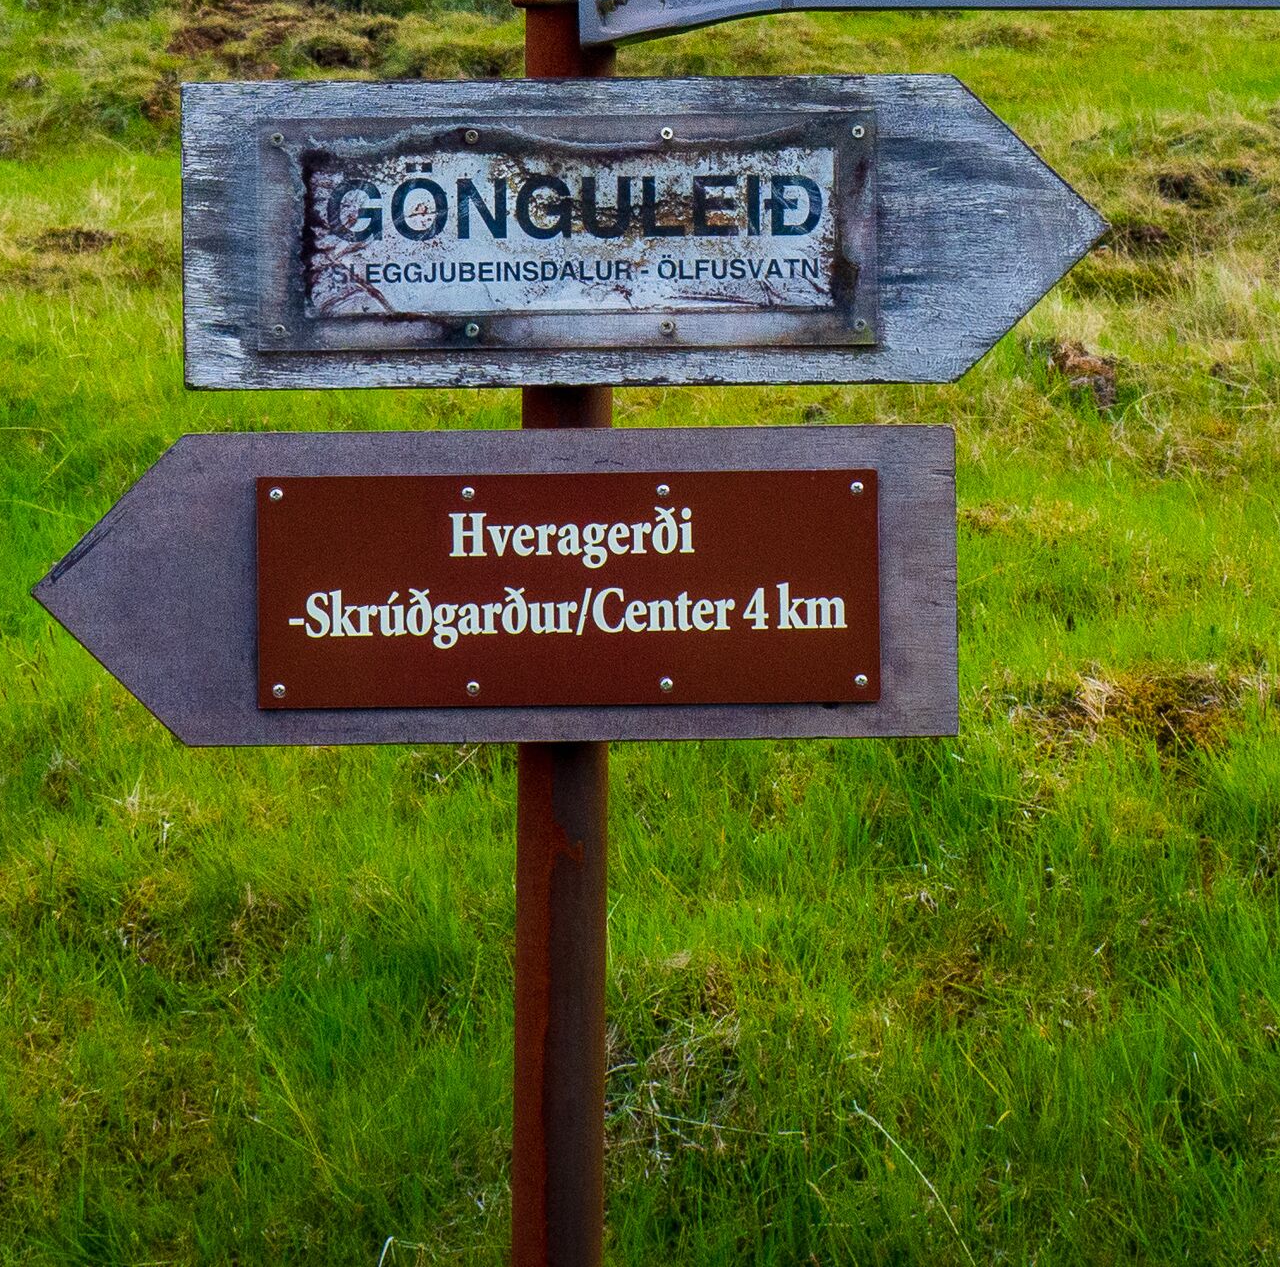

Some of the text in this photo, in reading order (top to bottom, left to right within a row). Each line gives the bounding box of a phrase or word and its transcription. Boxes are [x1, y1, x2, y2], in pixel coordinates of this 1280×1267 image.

[327, 162, 823, 241] GÖNGULEIÐ
[657, 254, 820, 281] ÖLFUSVATN
[448, 506, 695, 569] Hveragerði
[742, 587, 770, 631] 4
[777, 583, 848, 630] km
